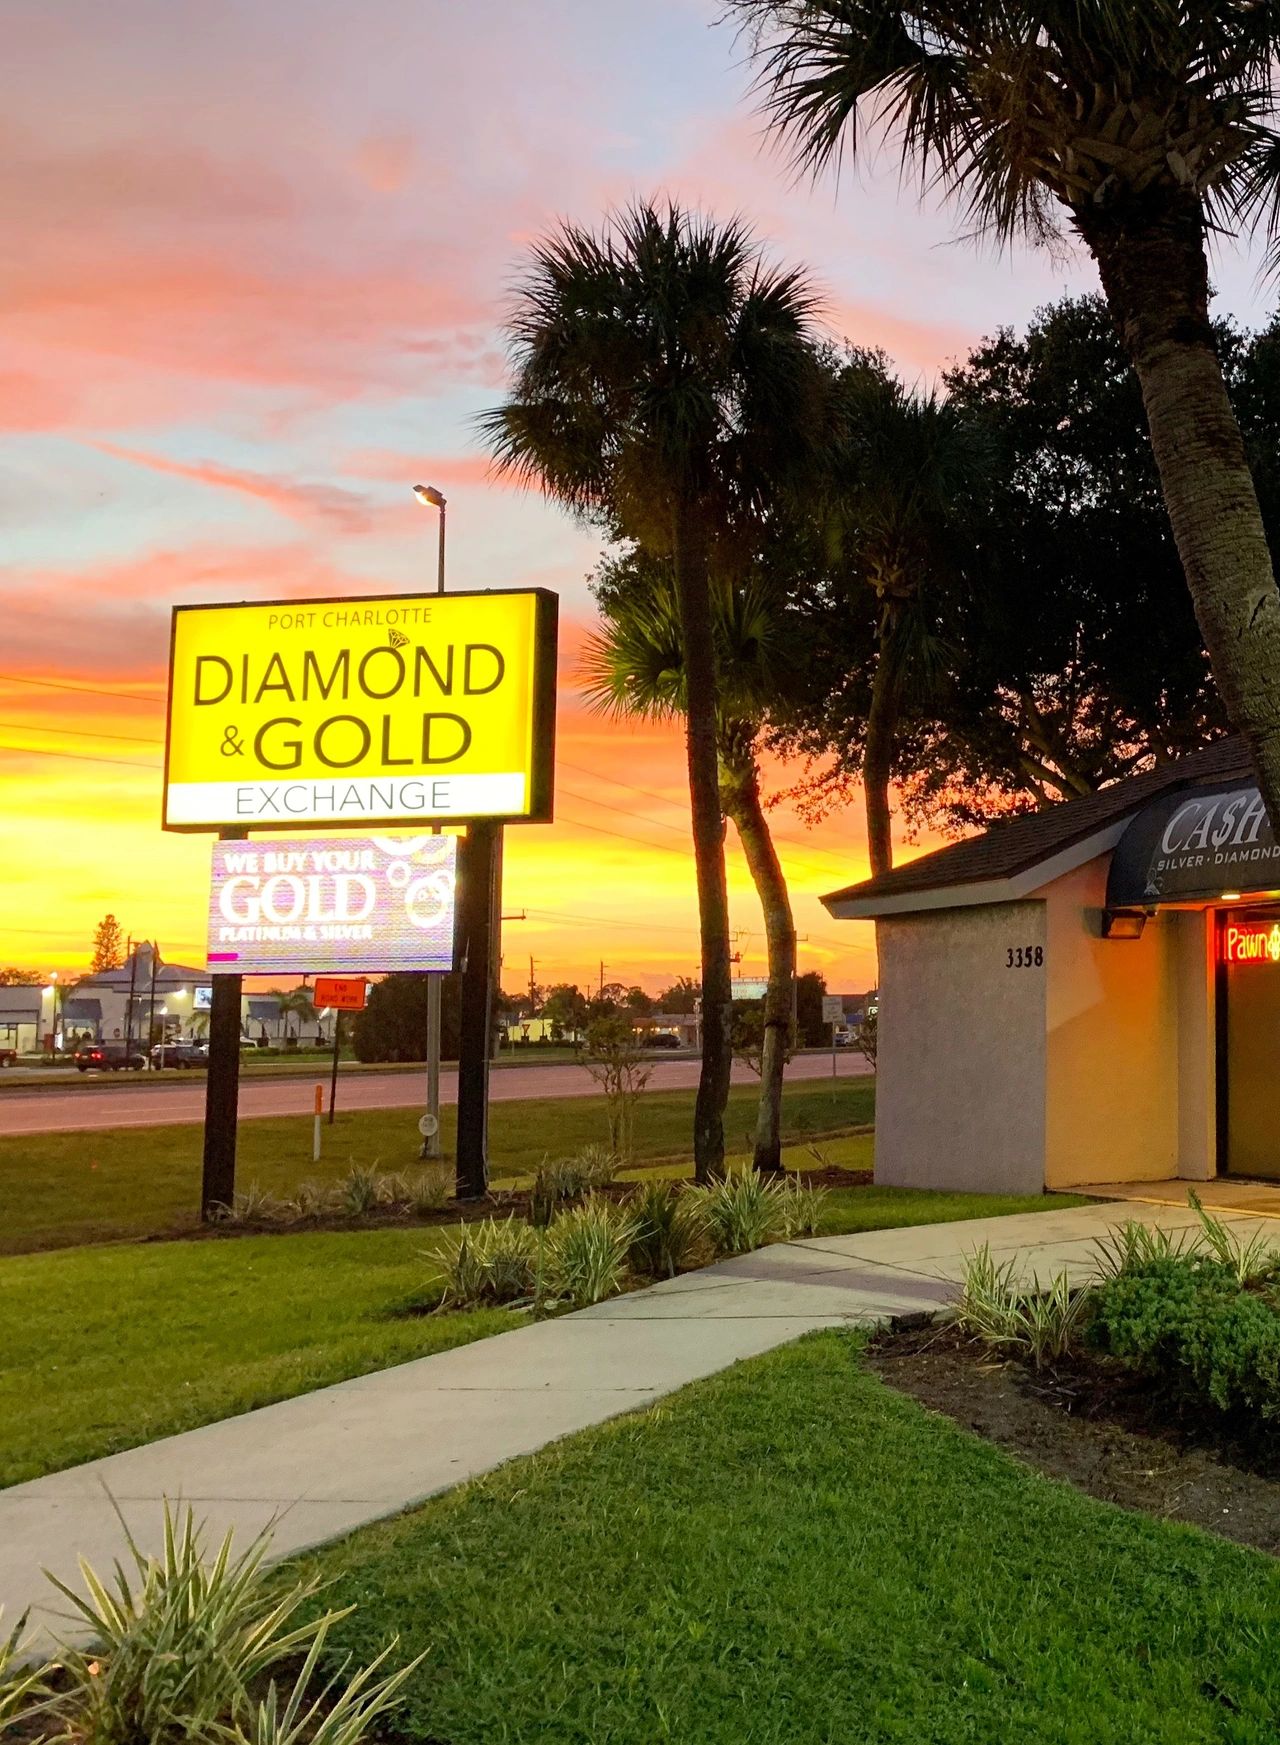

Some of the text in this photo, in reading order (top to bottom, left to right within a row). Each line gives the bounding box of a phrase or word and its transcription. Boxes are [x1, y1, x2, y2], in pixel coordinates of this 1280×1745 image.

[268, 607, 432, 630] PORT CHARLOTTE
[193, 642, 506, 707] DIAMOND
[219, 711, 472, 771] & GOLD
[235, 780, 452, 815] EXCHANGE
[223, 849, 377, 874] WE BUY YOUR
[1156, 855, 1204, 872] SILVER
[218, 873, 377, 924] GOLD
[1005, 945, 1044, 969] 3358
[1227, 927, 1269, 960] Pawn
